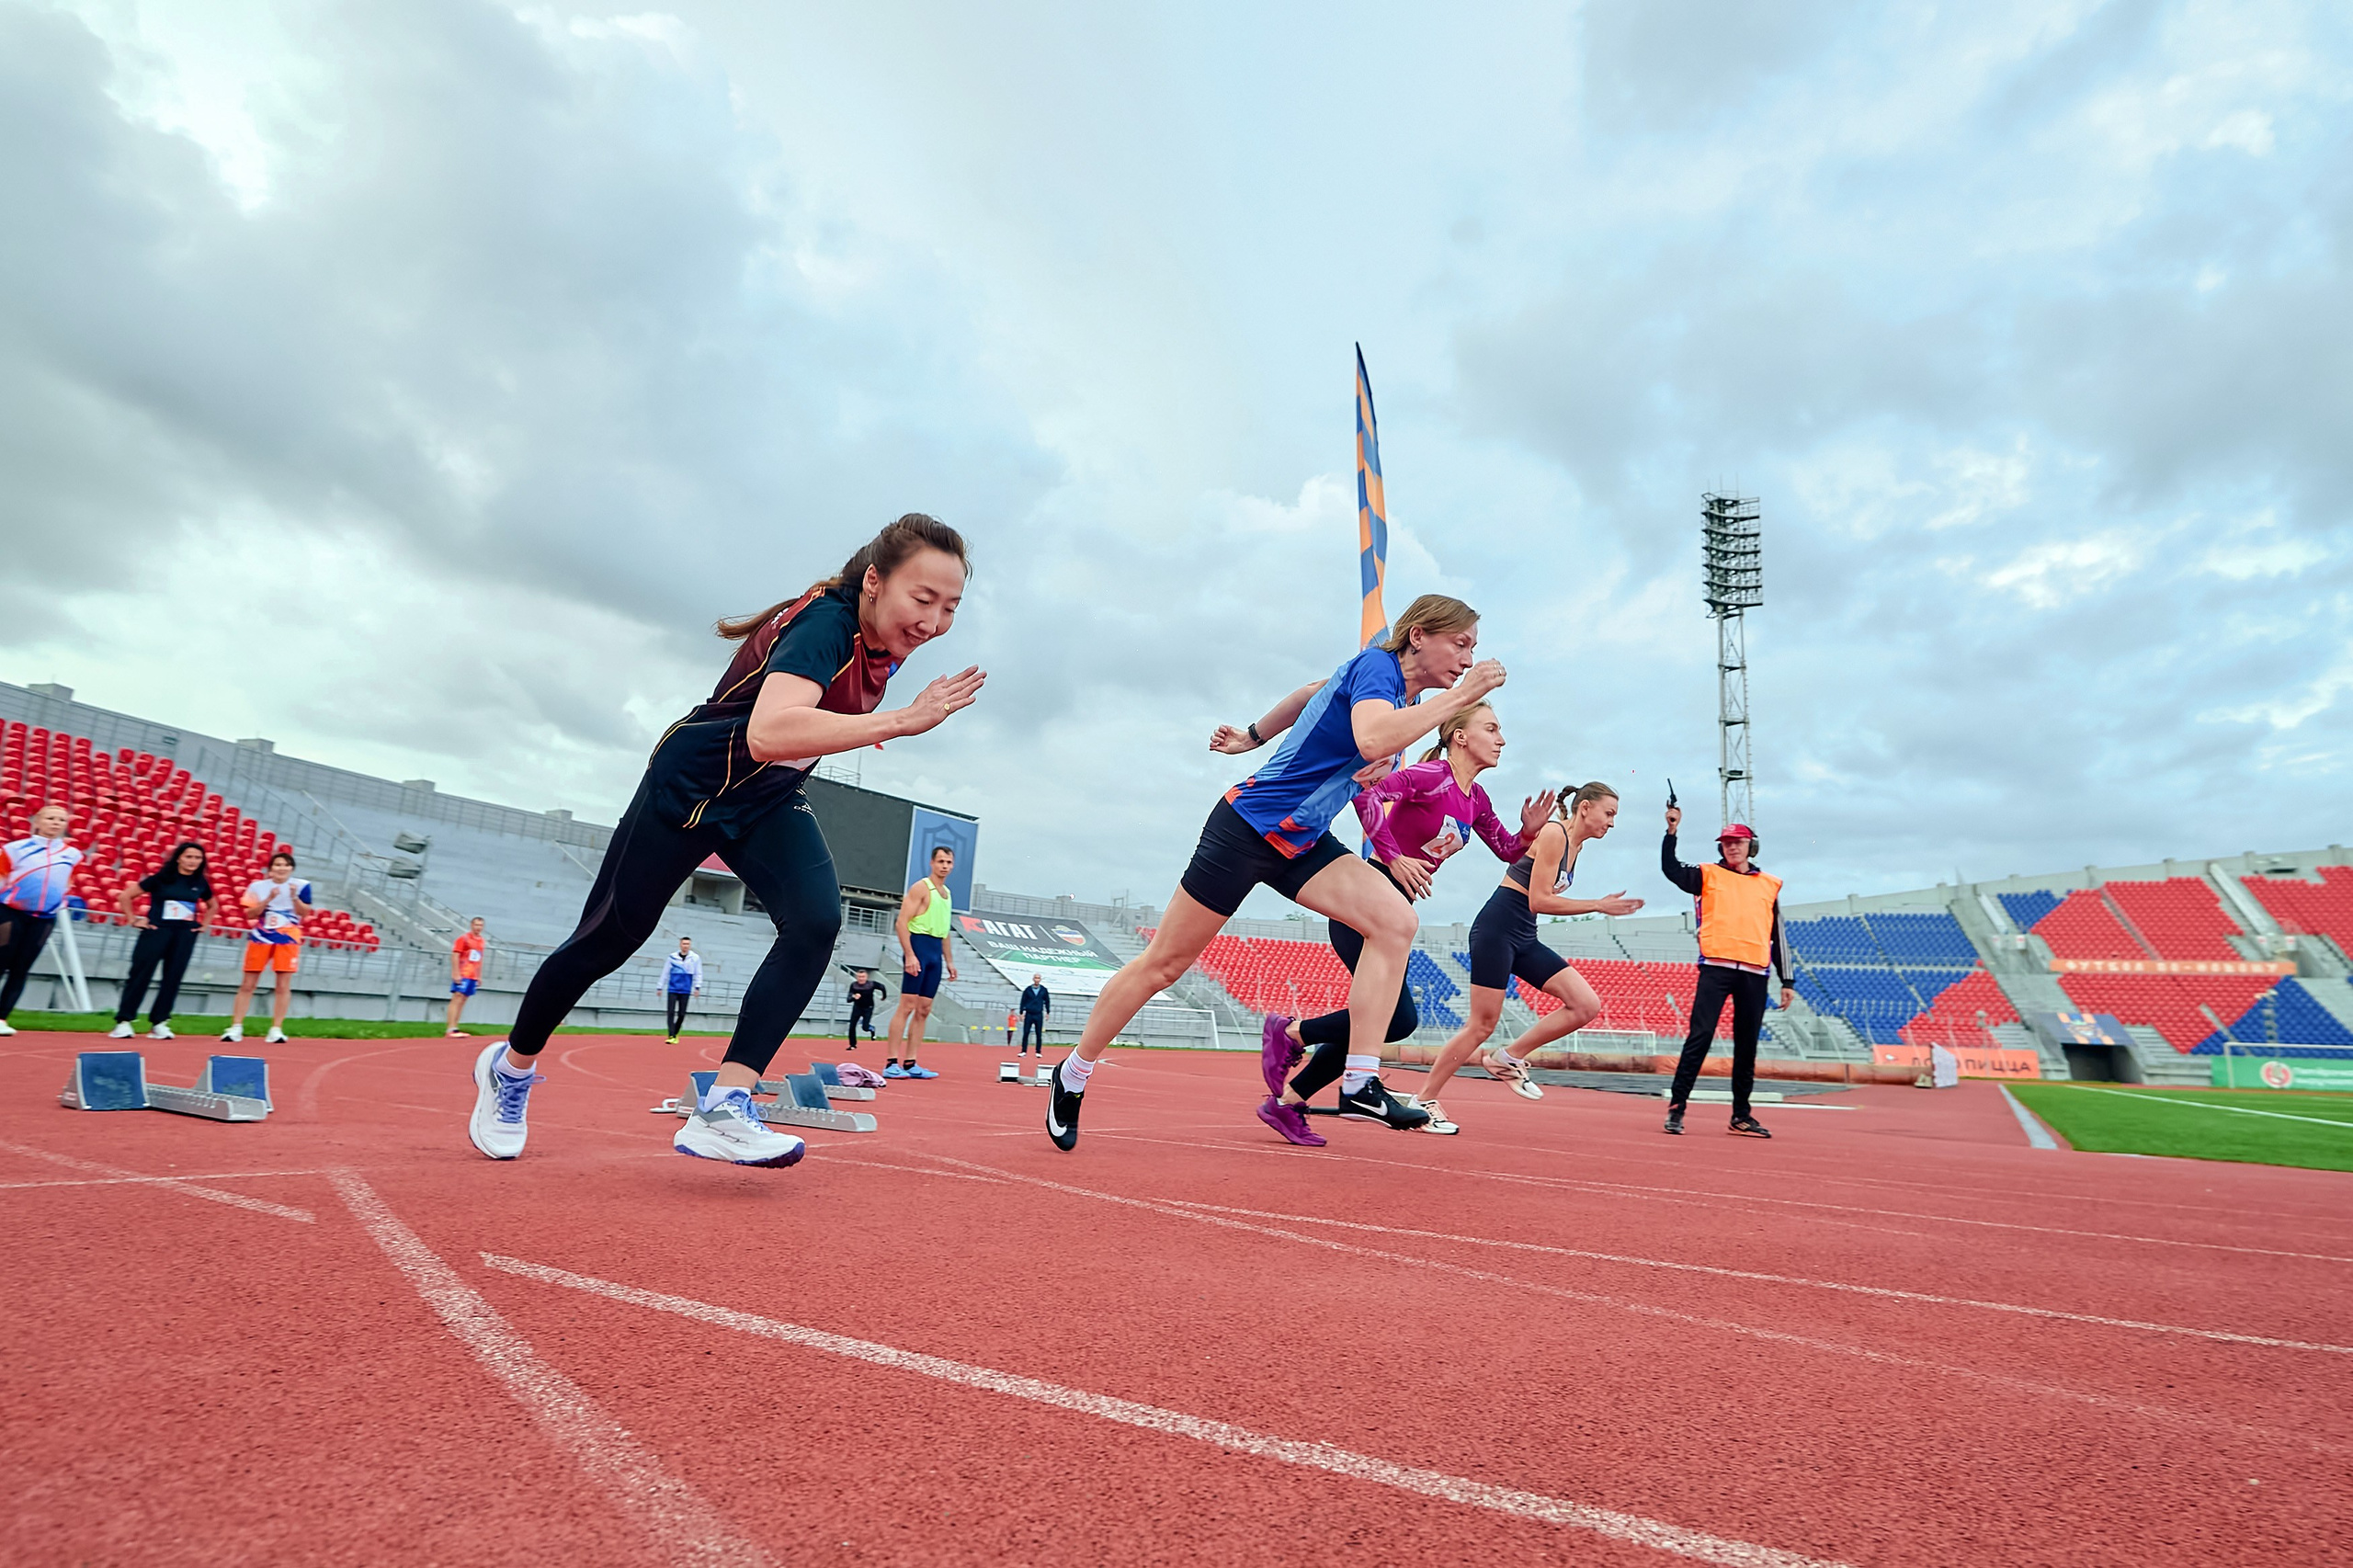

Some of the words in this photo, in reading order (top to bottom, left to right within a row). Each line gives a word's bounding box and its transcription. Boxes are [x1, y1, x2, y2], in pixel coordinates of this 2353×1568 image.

[1430, 832, 1456, 855] 2
[983, 919, 1038, 939] АГАТ
[986, 940, 1020, 951] ВАШ
[1021, 952, 1081, 963] ПАРТНЕР
